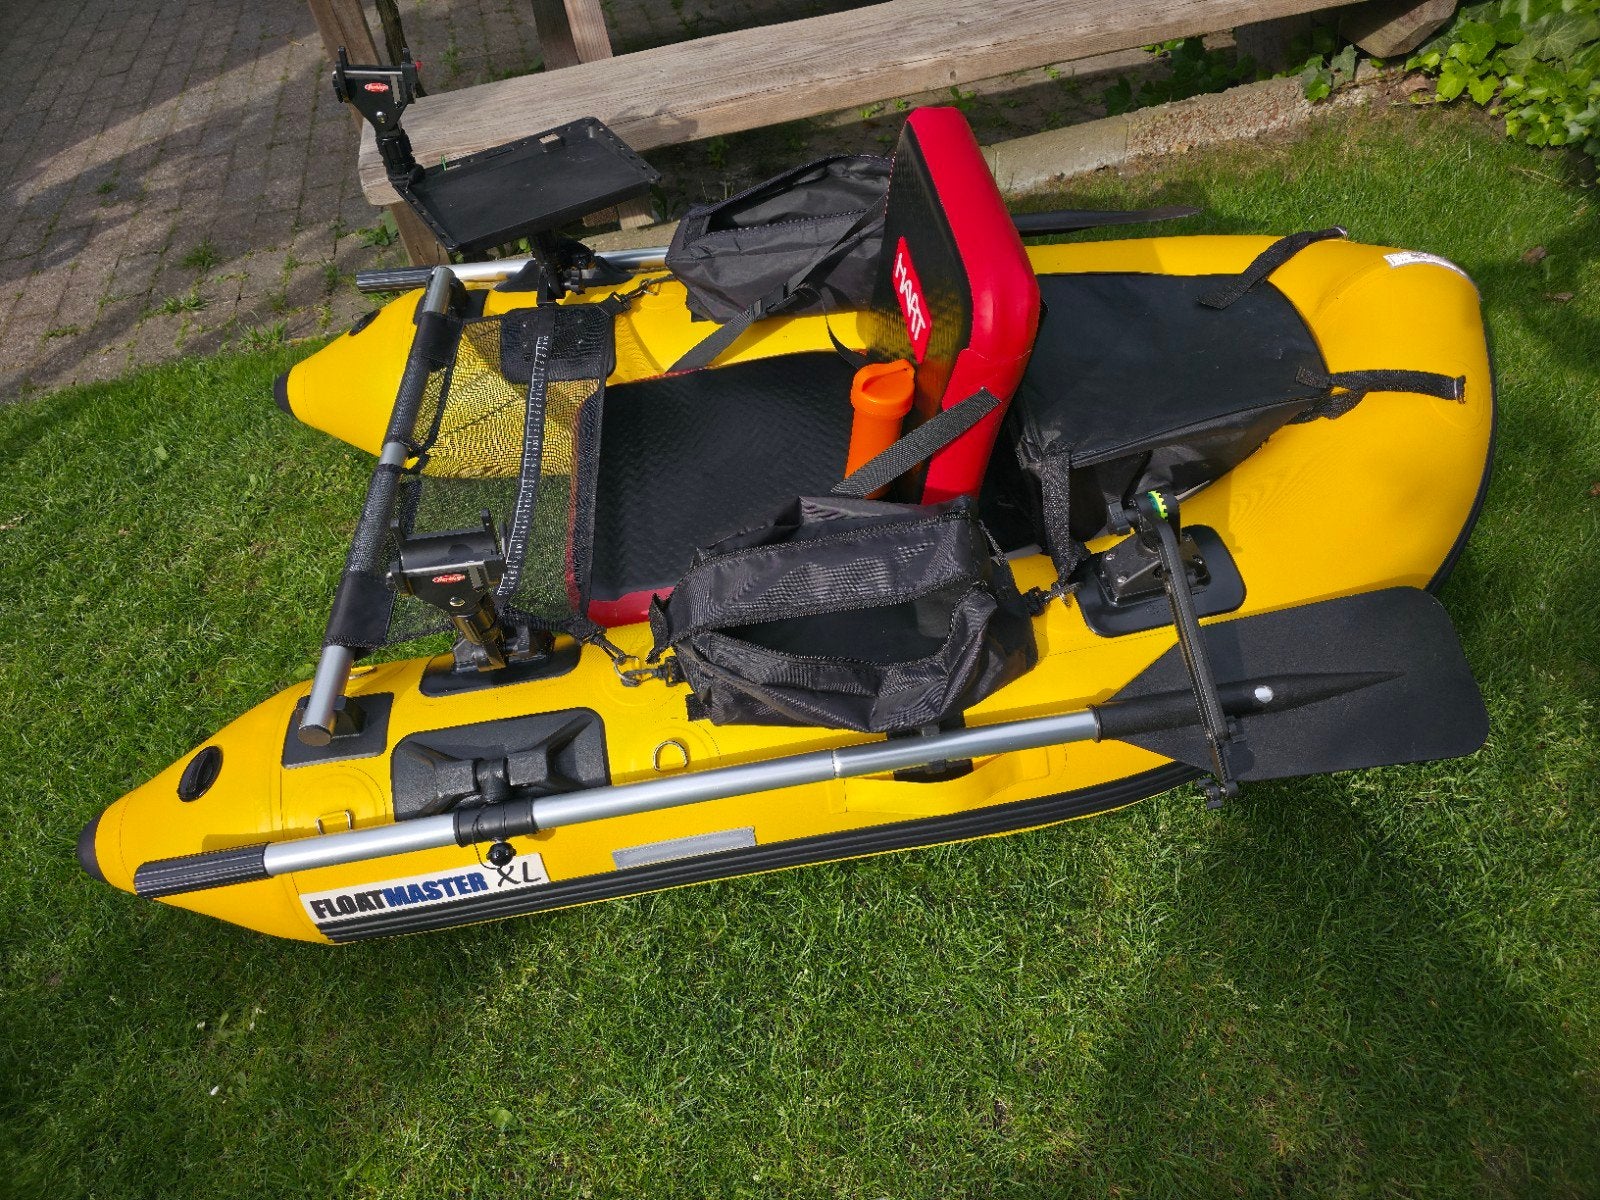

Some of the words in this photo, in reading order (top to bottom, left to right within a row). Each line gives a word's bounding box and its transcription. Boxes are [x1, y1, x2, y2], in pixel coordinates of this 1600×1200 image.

[894, 252, 926, 341] HART
[310, 872, 489, 919] FLOATMASTER
[497, 861, 542, 887] XL
